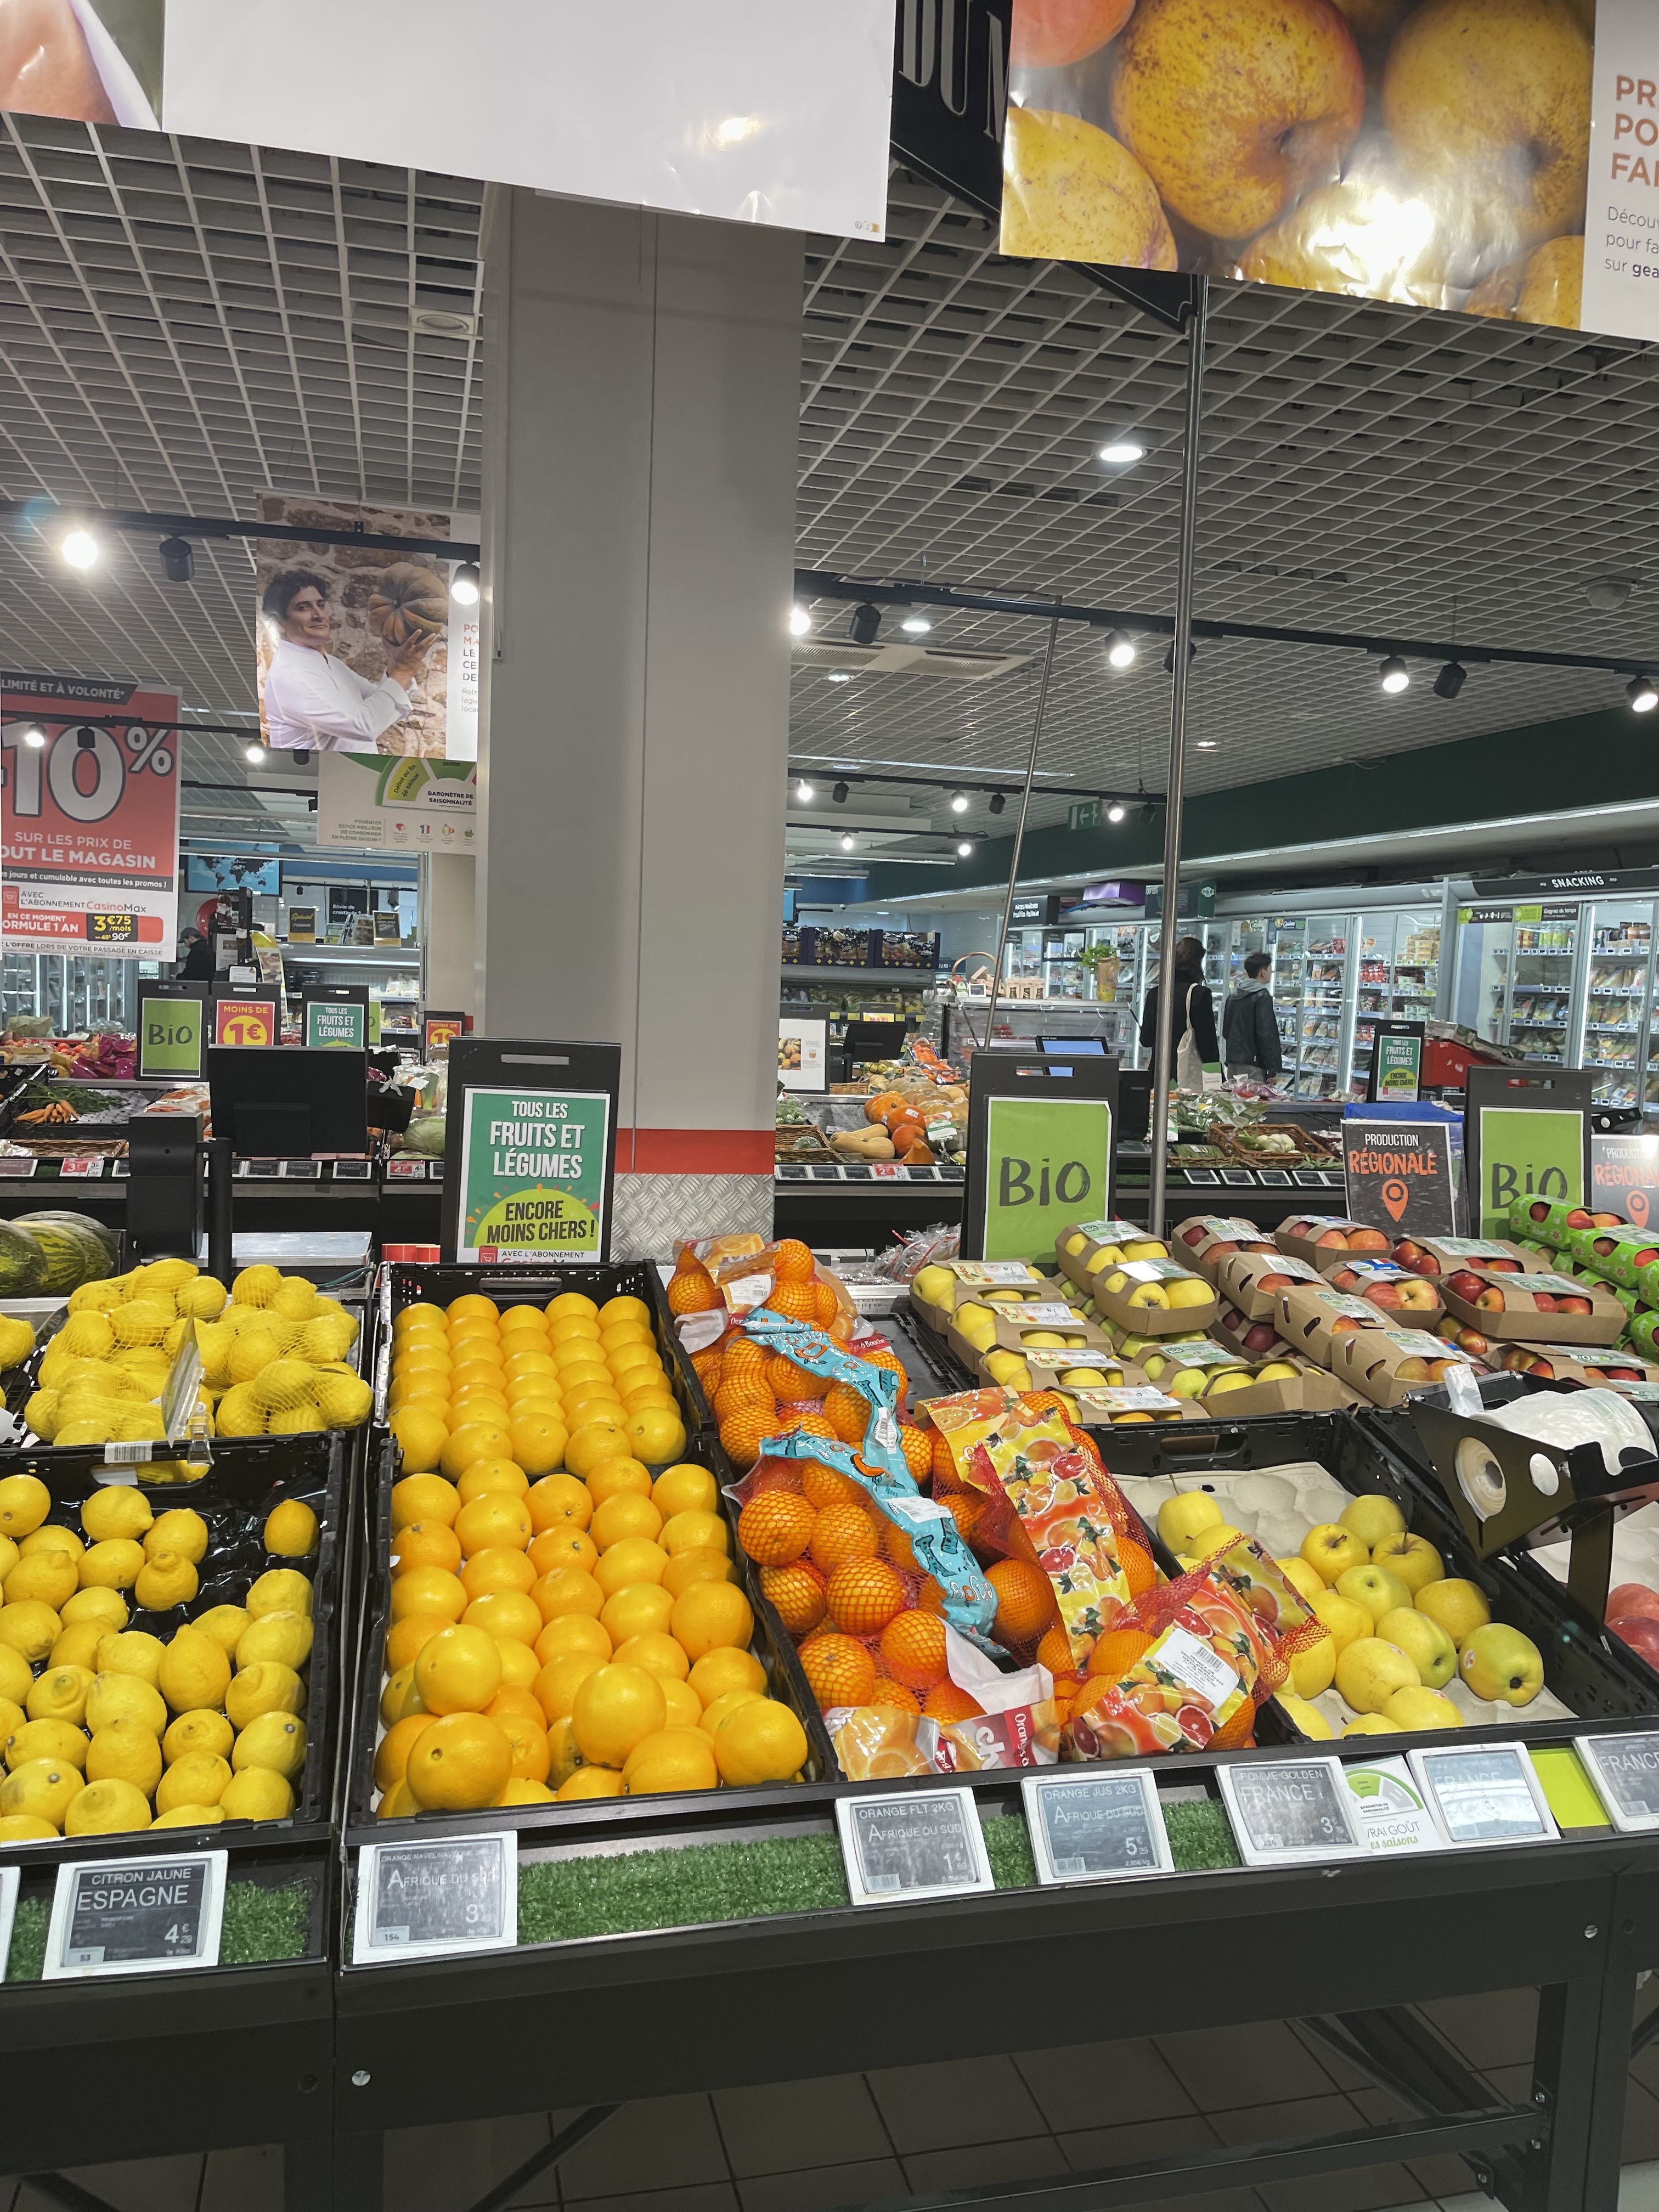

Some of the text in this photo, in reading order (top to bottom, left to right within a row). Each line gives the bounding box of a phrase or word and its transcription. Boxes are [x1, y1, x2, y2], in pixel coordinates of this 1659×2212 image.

[1616, 75, 1657, 108] PR
[1614, 113, 1659, 146] PO
[1606, 233, 1641, 251] pour
[1604, 258, 1628, 273] sur
[462, 673, 479, 681] DE
[1, 679, 37, 691] LIMITÉ
[40, 683, 53, 692] ET
[56, 682, 65, 693] À
[15, 832, 132, 850] SUR LES PRIX DE
[41, 848, 64, 862] LE
[69, 850, 155, 868] MAGASIN
[9, 870, 28, 879] jours
[40, 873, 77, 883] cumulable
[98, 877, 121, 885] toutes
[135, 880, 162, 888] promos
[1551, 876, 1604, 888] SNACKING
[21, 899, 146, 913] L'ABONNEMENT CasinoMax
[32, 913, 66, 922] MOMENT
[53, 922, 59, 932] 1
[61, 923, 79, 933] AN
[224, 1006, 253, 1014] MOINS
[317, 1015, 354, 1026] FRUITS ET
[319, 1026, 354, 1037] LÉGUMES
[1386, 1046, 1413, 1056] FRUITS ET
[1387, 1056, 1413, 1065] LÉGUMES
[511, 1101, 568, 1119] TOUS LES
[490, 1121, 585, 1148] FRUITS ET
[1365, 1134, 1419, 1147] PRODUCTION
[1606, 1147, 1643, 1159] PRODUCT
[493, 1148, 583, 1179] LÉGUMES
[1349, 1148, 1438, 1176] RÉGIONALE
[505, 1200, 564, 1221] ENCORE
[487, 1220, 595, 1244] MOINS CHERS !
[865, 1339, 885, 1347] Bouche
[1240, 1770, 1323, 1781] POMME GOLDEN
[1045, 1784, 1136, 1801] ORANGE JUS 2KG
[1240, 1784, 1316, 1803] FRANCE
[859, 1802, 955, 1819] ORANGE FLT 2KG
[1107, 1809, 1120, 1819] DU
[1123, 1807, 1143, 1817] SUD
[923, 1826, 937, 1836] DU
[941, 1824, 961, 1834] SUD
[1388, 1820, 1420, 1835] GOÛT
[1383, 1836, 1418, 1848] saisons
[92, 1868, 191, 1885] CITRON JAUNE
[452, 1874, 467, 1884] DU
[76, 1884, 190, 1911] ESPAGNE
